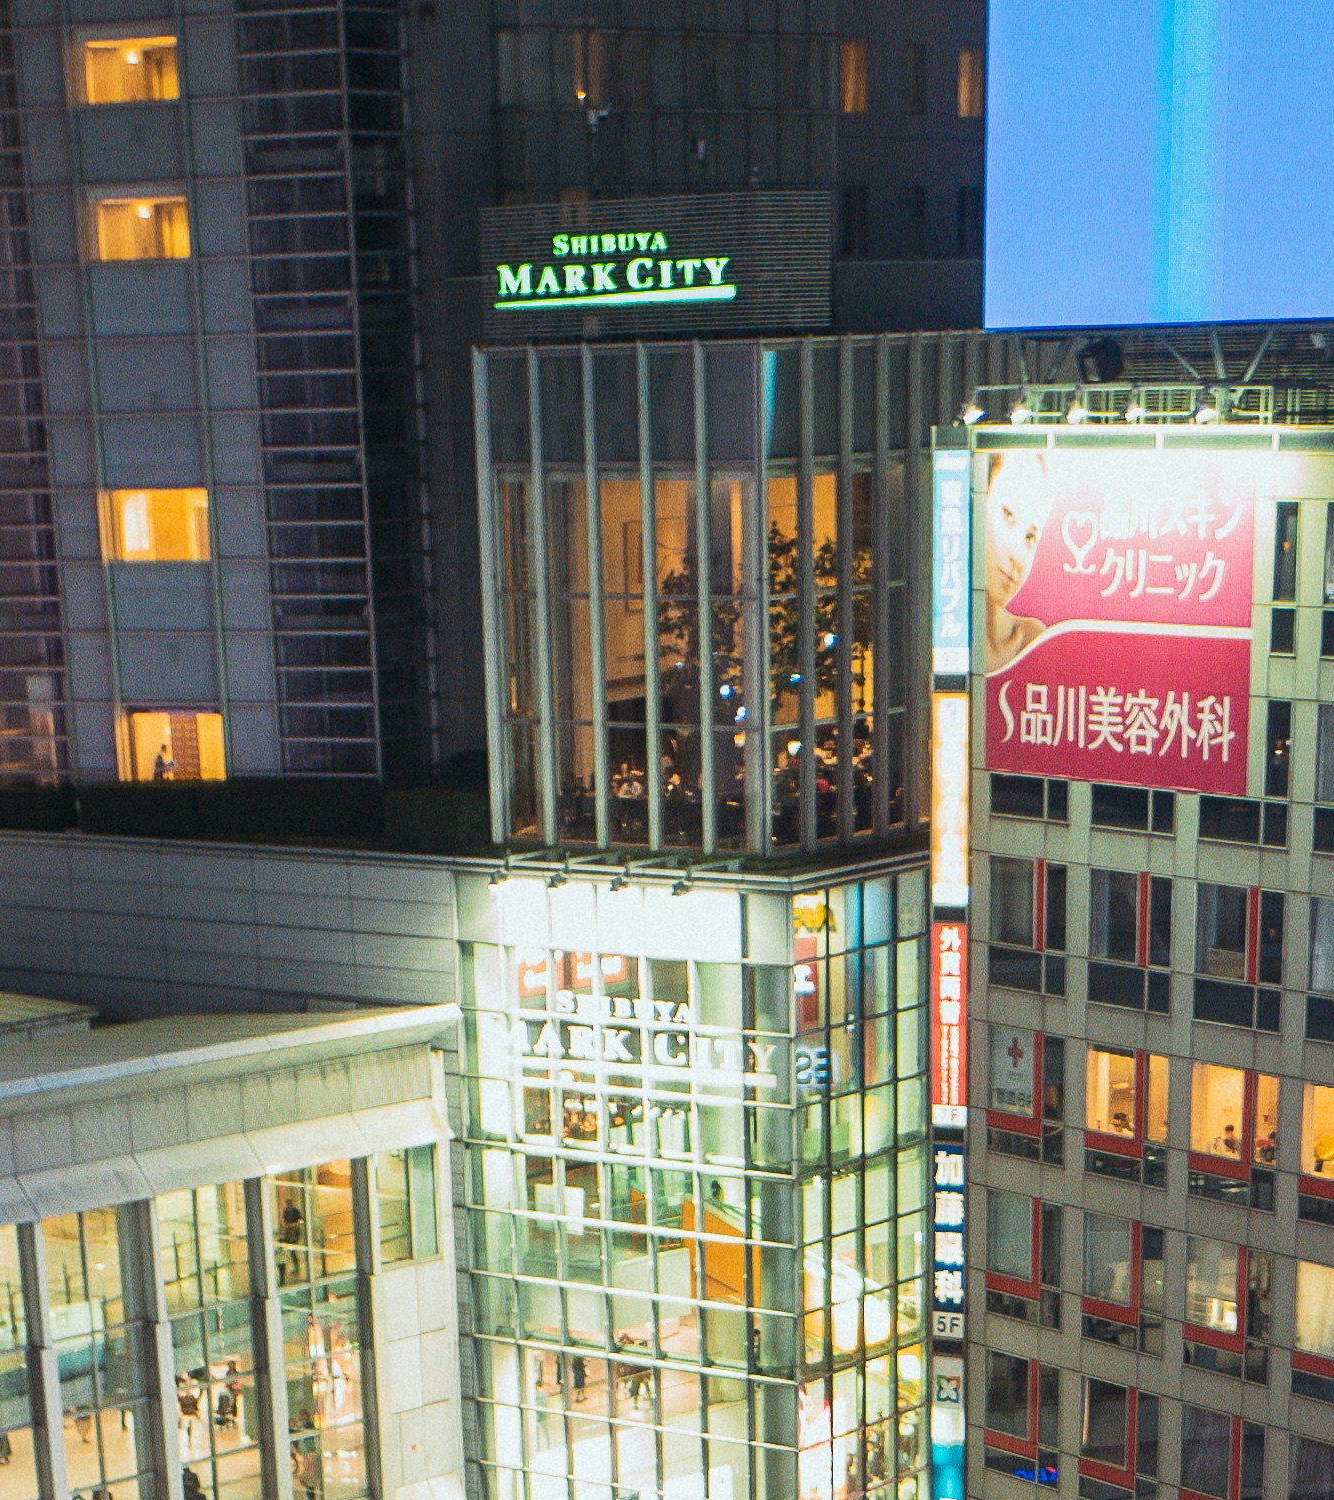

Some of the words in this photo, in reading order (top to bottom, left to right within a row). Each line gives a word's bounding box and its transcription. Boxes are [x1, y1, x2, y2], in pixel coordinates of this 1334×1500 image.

[553, 231, 667, 256] SHIBUYA
[496, 263, 617, 294] MARK
[626, 257, 730, 288] CITY
[1099, 549, 1227, 601] クリニック
[1019, 683, 1236, 763] 品川美容外科
[935, 1314, 962, 1335] 5F
